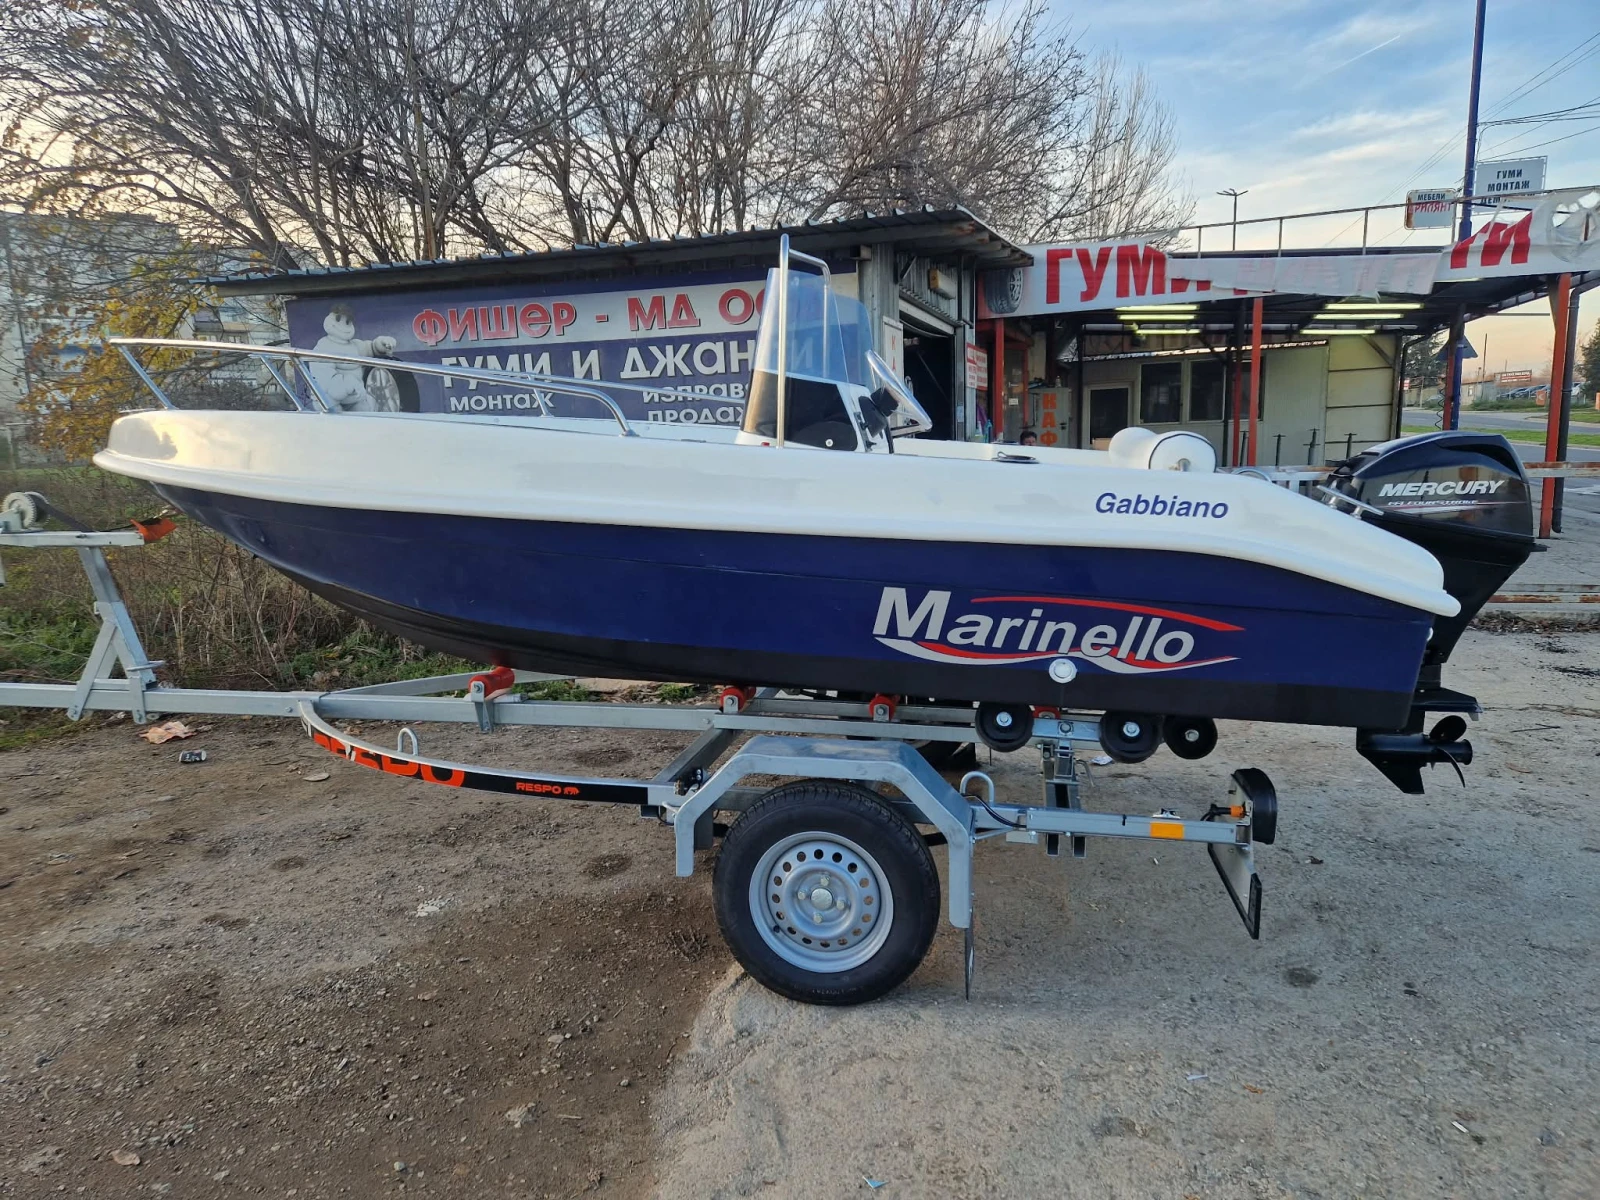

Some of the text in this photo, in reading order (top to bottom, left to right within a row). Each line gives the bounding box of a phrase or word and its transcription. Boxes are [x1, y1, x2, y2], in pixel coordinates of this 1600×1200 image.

[1496, 169, 1523, 180] ГУМИ
[1417, 193, 1446, 201] МЕБЕЛИ
[1487, 181, 1531, 193] МОНТАЖ
[412, 302, 577, 347] ФИШЕР
[627, 293, 701, 331] МД
[441, 352, 553, 390] ГУМИ
[571, 349, 601, 381] И
[450, 391, 554, 413] МОНТАЖ
[643, 382, 749, 403] ИЗПРАВ
[1378, 480, 1505, 497] MERCURY
[1095, 492, 1229, 519] Gabbiano
[872, 586, 1195, 664] Marinello
[516, 782, 562, 795] RESPO
